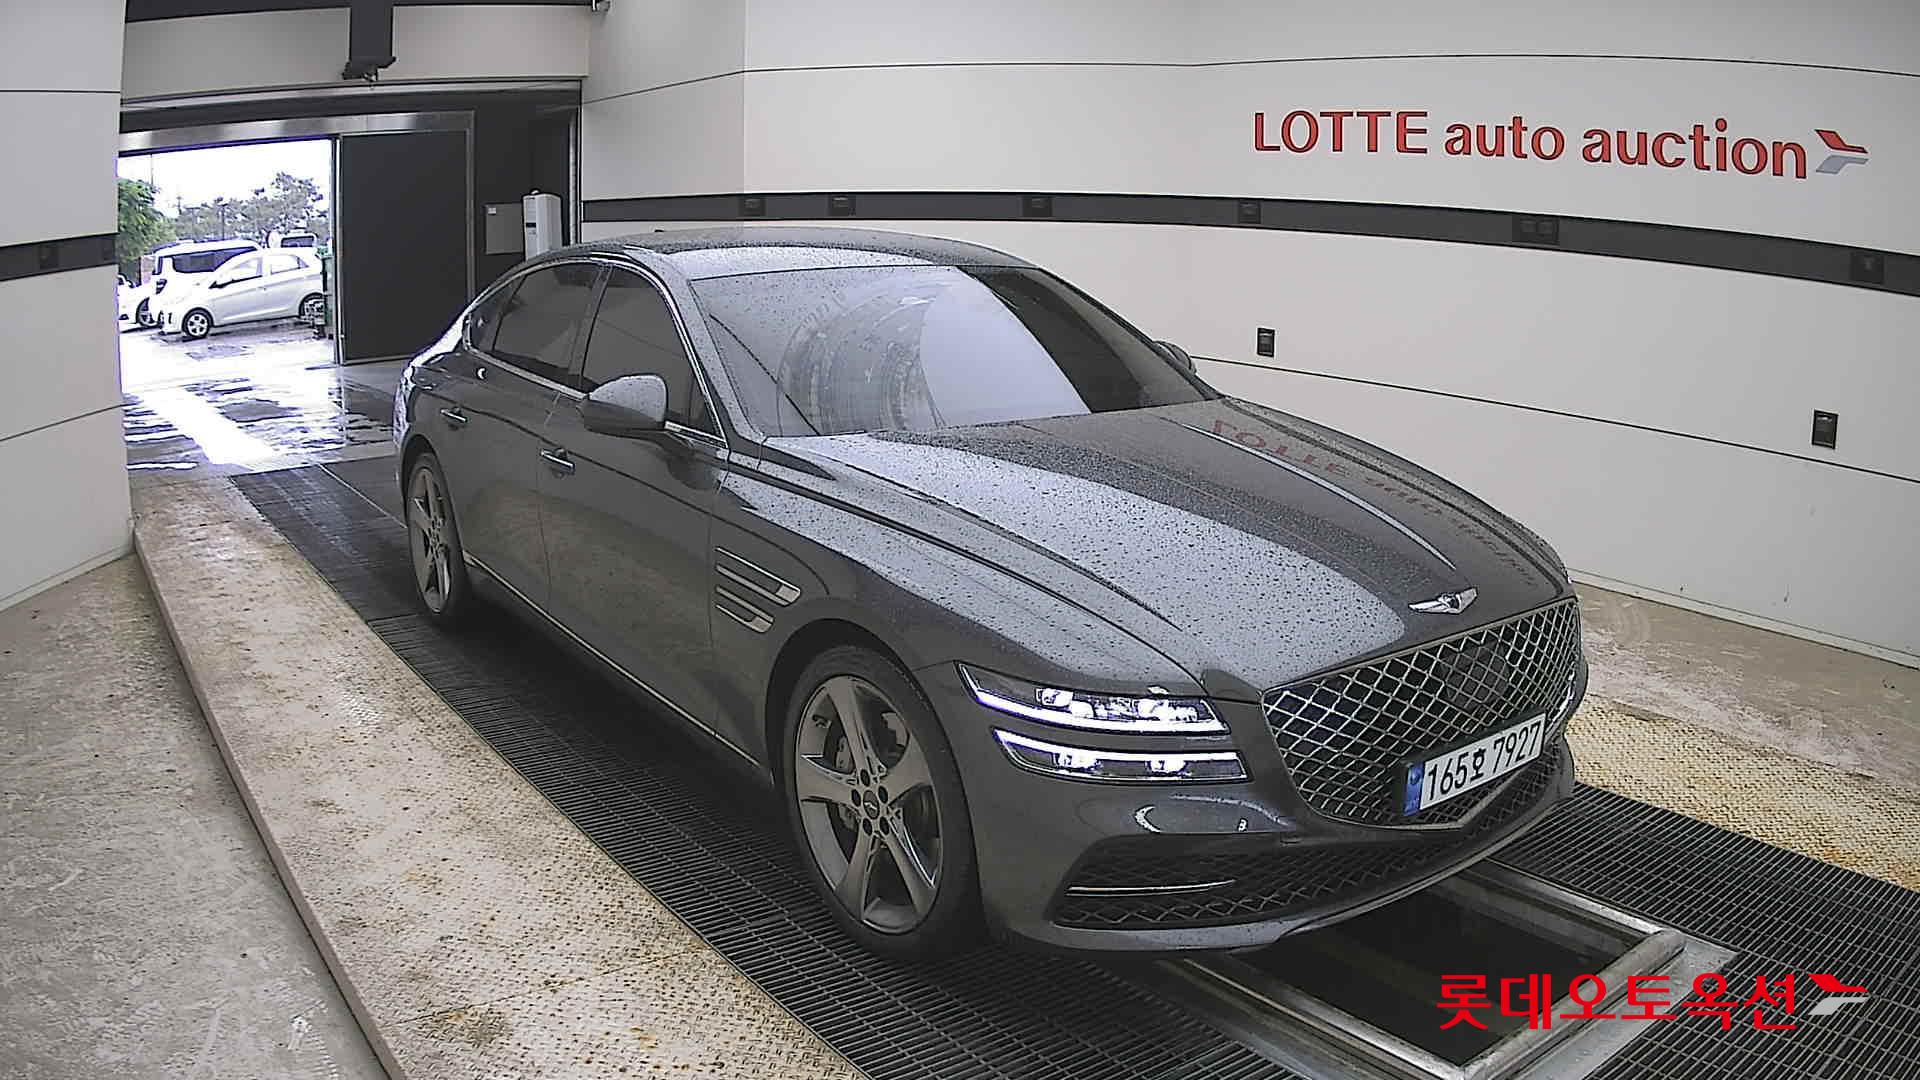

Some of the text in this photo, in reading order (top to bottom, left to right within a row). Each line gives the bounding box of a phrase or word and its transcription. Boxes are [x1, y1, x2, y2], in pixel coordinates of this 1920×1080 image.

[1254, 111, 1808, 180] LOTTE auto auction
[1428, 721, 1542, 801] 165호 7927
